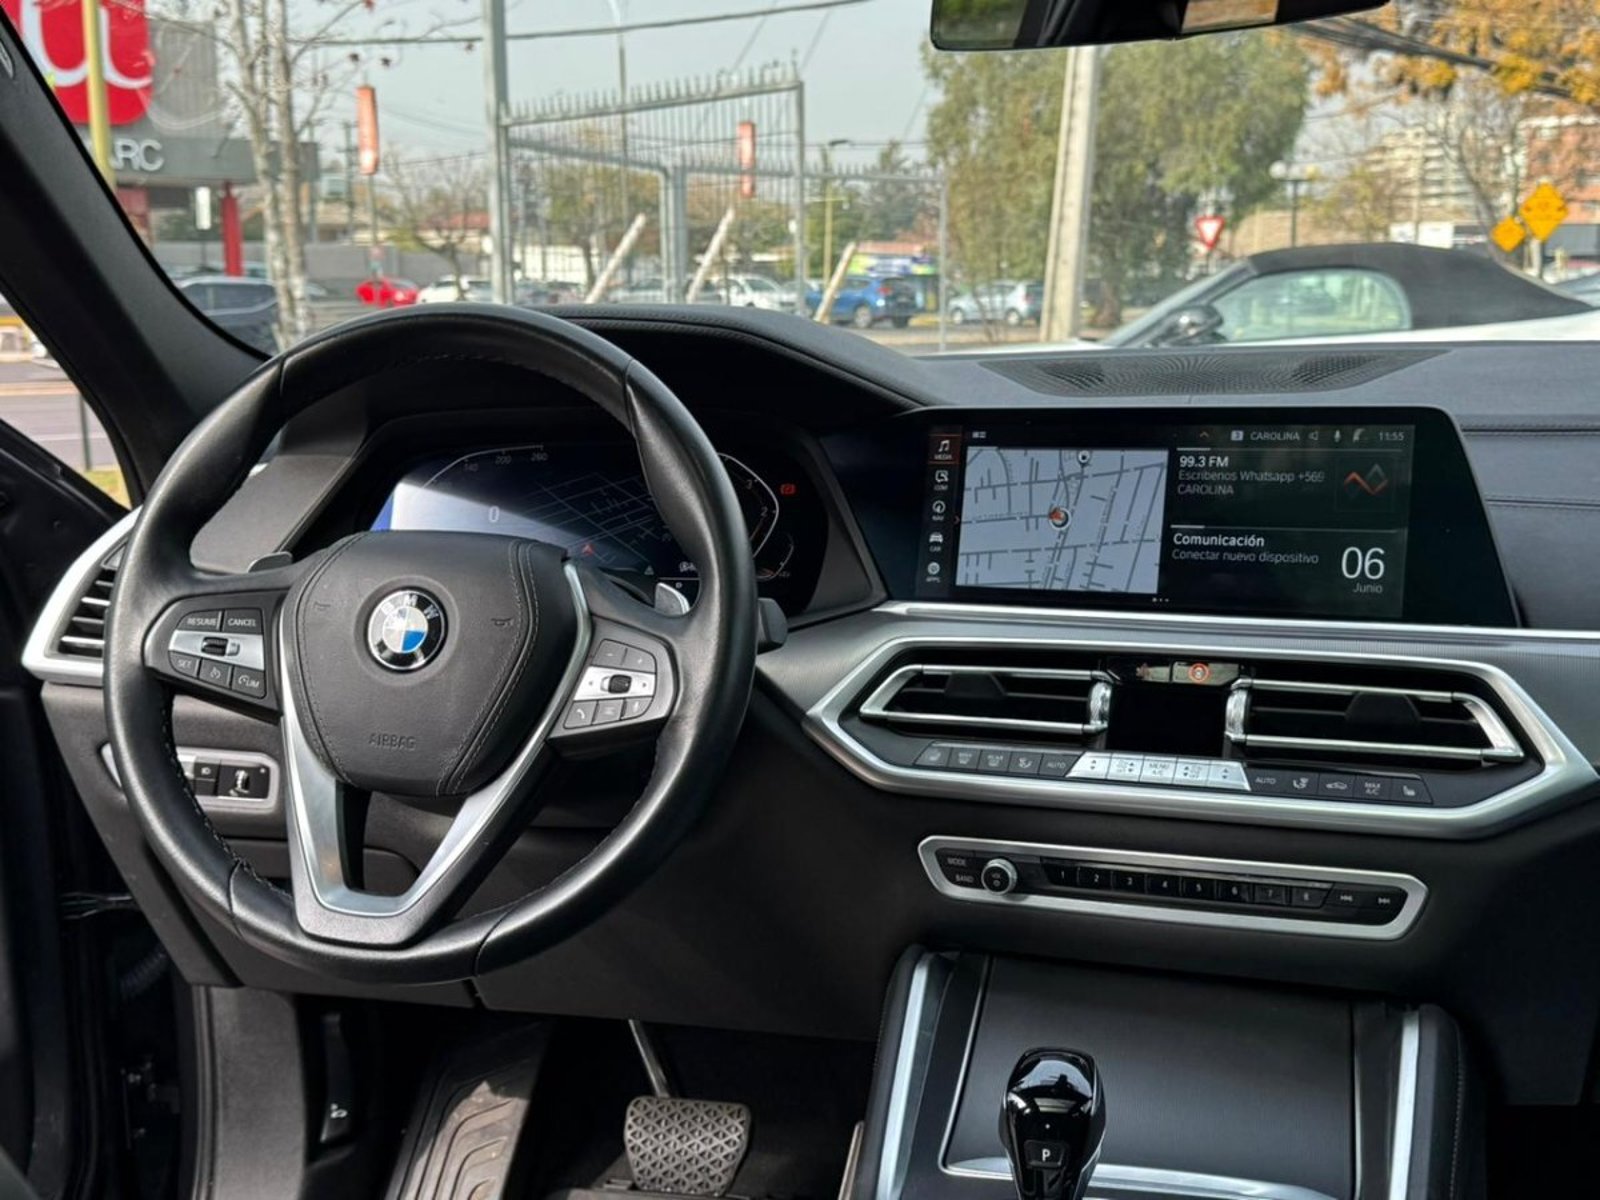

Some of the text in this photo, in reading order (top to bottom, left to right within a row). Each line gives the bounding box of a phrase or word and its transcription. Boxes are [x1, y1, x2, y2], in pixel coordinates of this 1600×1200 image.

[1250, 431, 1300, 441] CAROLINA
[1378, 431, 1404, 441] 11:55
[1179, 456, 1229, 467] 99.3 FM
[1240, 470, 1295, 484] Whatsapp
[1177, 485, 1234, 495] CAROLINA
[1173, 533, 1265, 547] Comunicación
[1172, 550, 1319, 565] Conectar nuevo dispositivo
[1341, 547, 1386, 580] 06
[1352, 583, 1384, 594] Junio
[187, 618, 217, 626] RESUME
[228, 618, 257, 627] CANCEL
[368, 733, 417, 750] AIRBAG
[1047, 761, 1066, 769] AUTO
[1255, 777, 1276, 785] AUTO
[1042, 1149, 1050, 1162] P
